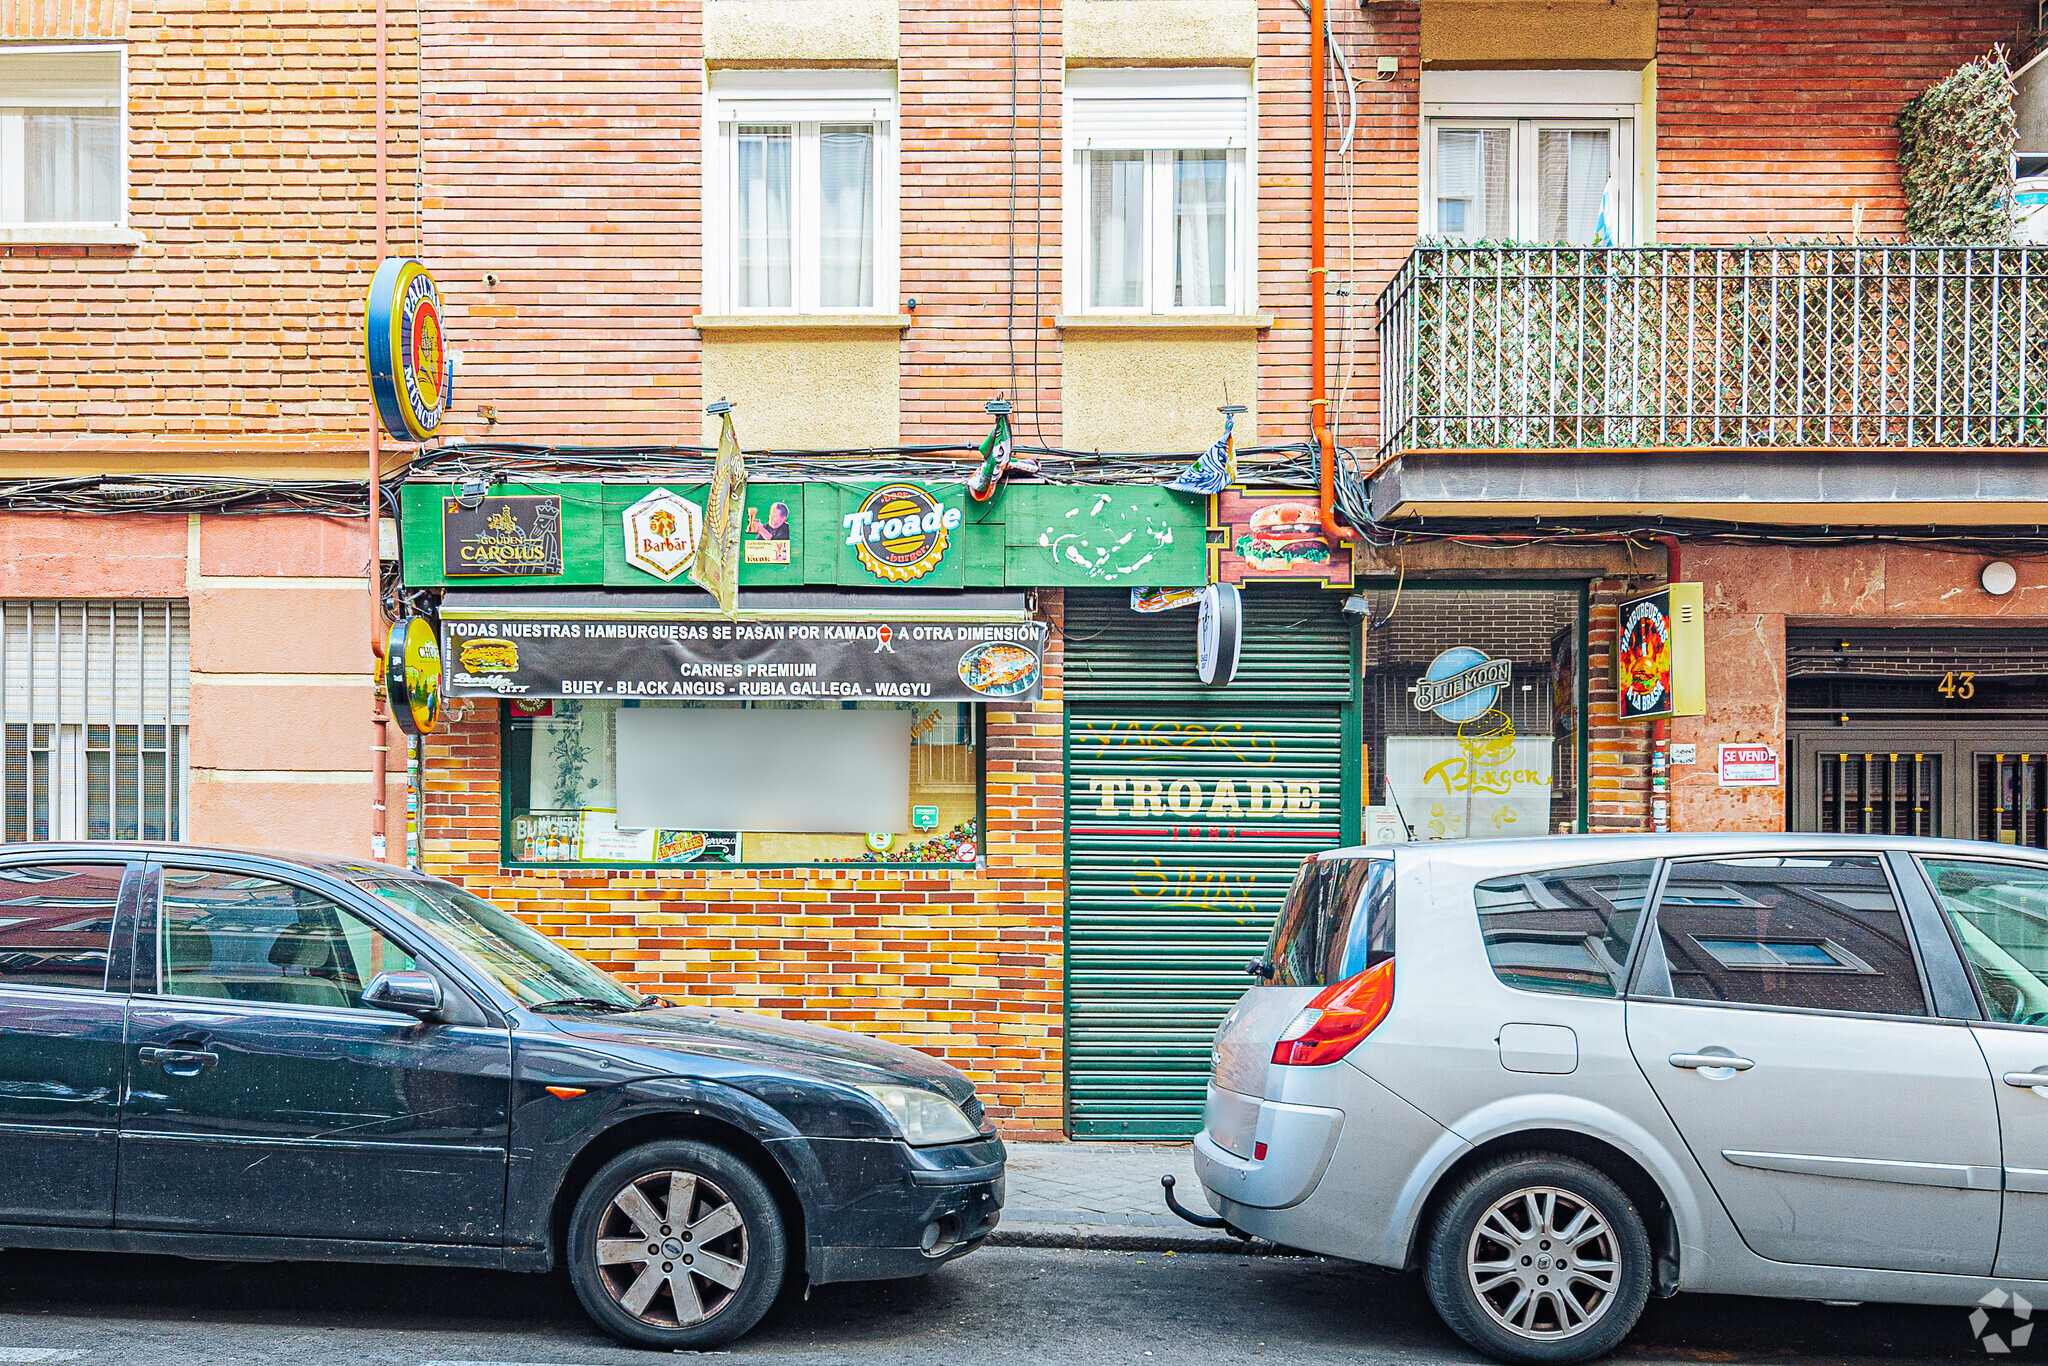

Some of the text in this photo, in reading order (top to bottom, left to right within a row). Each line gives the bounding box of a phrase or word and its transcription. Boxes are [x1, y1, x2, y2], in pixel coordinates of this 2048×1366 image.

[843, 502, 961, 546] Troade
[480, 536, 524, 545] GOUDEN
[460, 545, 545, 563] CAROLUS
[889, 545, 926, 562] burger
[448, 623, 497, 637] TODAS
[502, 623, 580, 638] NUESTRAS
[585, 624, 708, 639] HAMBURGUESAS
[713, 626, 731, 639] SE
[735, 626, 784, 639] PASAN
[789, 626, 818, 639] POR
[898, 626, 909, 640] A
[913, 626, 953, 640] OTRA
[958, 624, 1039, 640] DIMENSIÓN
[1621, 601, 1669, 653] HAMBURGUESAS
[681, 663, 816, 677] CARNES PREMIUM
[453, 673, 513, 688] Brooklyn
[498, 685, 530, 693] CITY
[562, 680, 603, 694] BUEY
[617, 681, 671, 694] BLACK
[674, 681, 724, 694] ANGUS
[740, 682, 785, 695] RUBIA
[790, 682, 862, 696] GALLEGA
[875, 683, 931, 696] WAGYU
[1418, 664, 1508, 708] BLUE MOON
[1937, 672, 1975, 699] 43
[1626, 680, 1664, 711] A LA BRASA
[911, 708, 943, 743] urger
[1724, 751, 1736, 762] SE
[1089, 779, 1321, 818] TROADE
[1170, 824, 1235, 842] 1983
